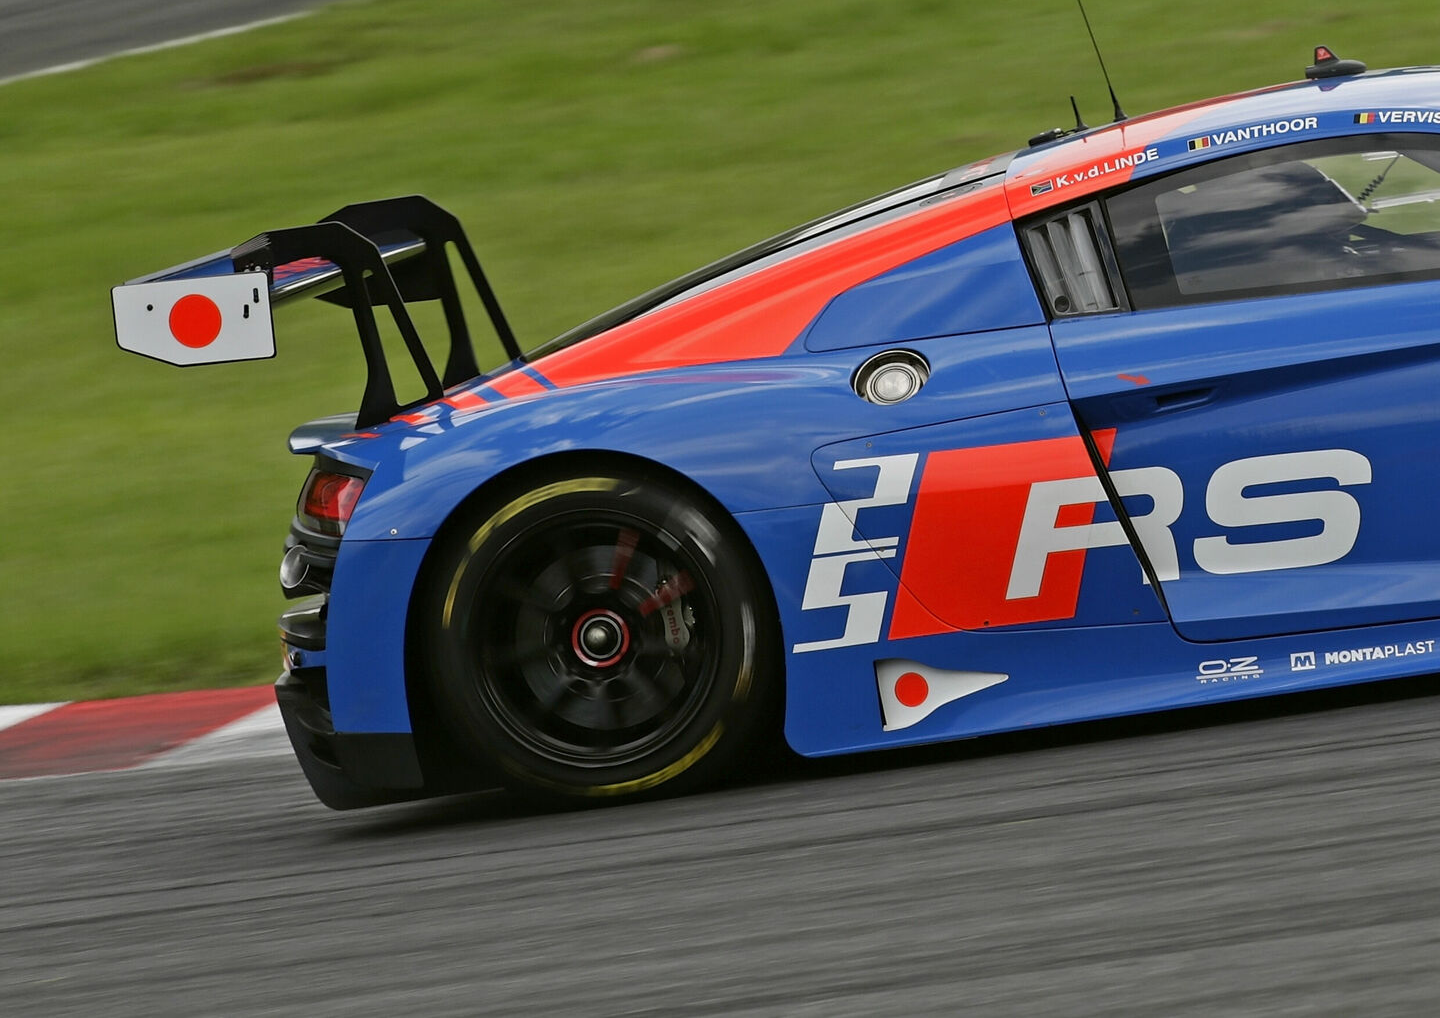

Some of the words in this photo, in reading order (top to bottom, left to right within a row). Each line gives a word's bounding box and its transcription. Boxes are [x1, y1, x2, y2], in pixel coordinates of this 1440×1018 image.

[1212, 116, 1318, 145] VANTHOOR
[1056, 147, 1159, 188] K.v.d.LINDE
[1005, 448, 1373, 600] RS
[1325, 640, 1435, 665] MONTAPLAST
[1200, 674, 1260, 684] RACING
